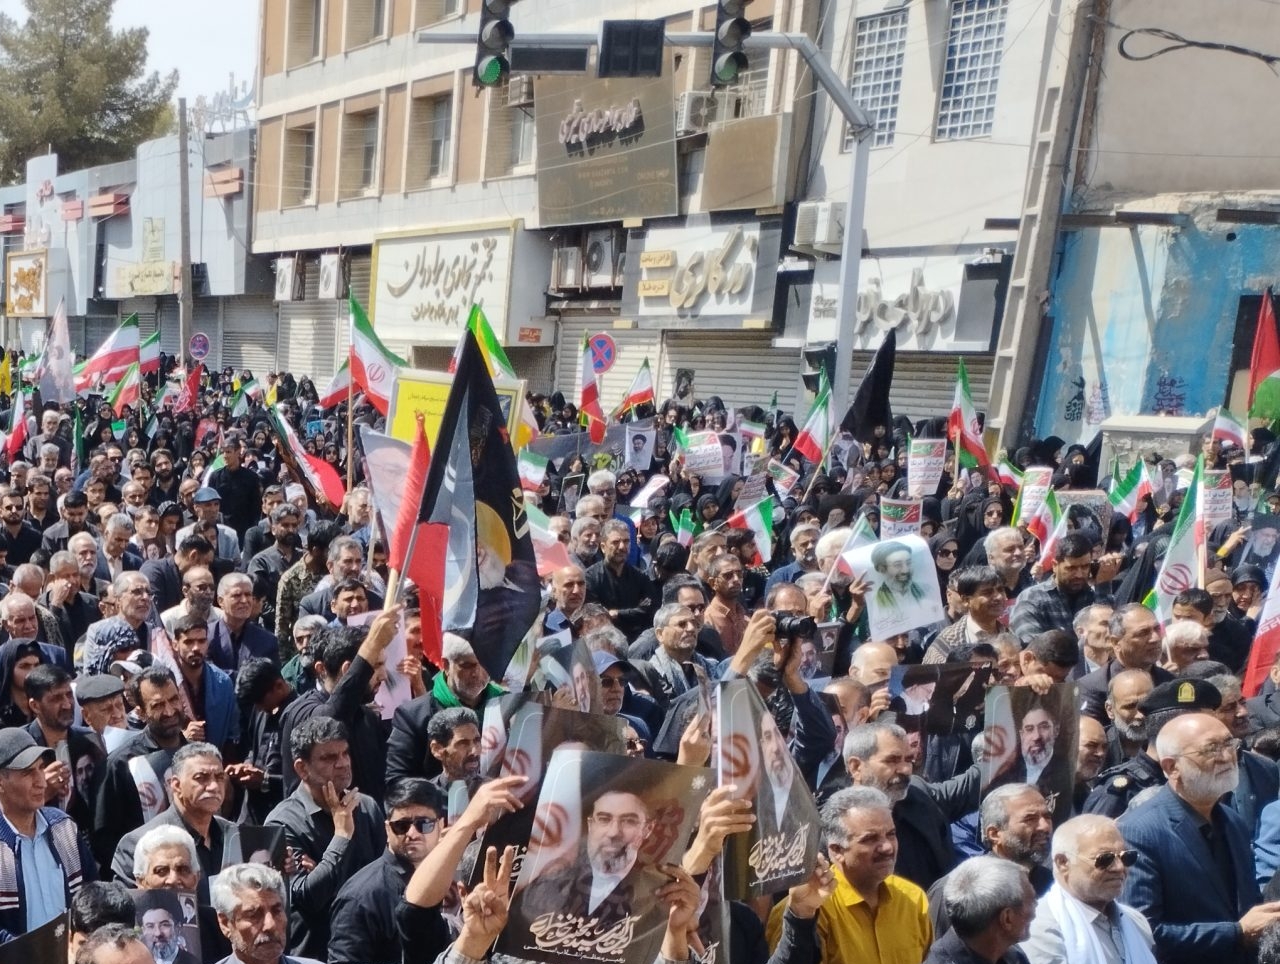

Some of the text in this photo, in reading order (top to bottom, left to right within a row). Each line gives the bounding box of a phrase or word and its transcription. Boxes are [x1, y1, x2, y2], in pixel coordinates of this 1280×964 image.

[387, 238, 498, 310] مجتمع تجاری برادران
